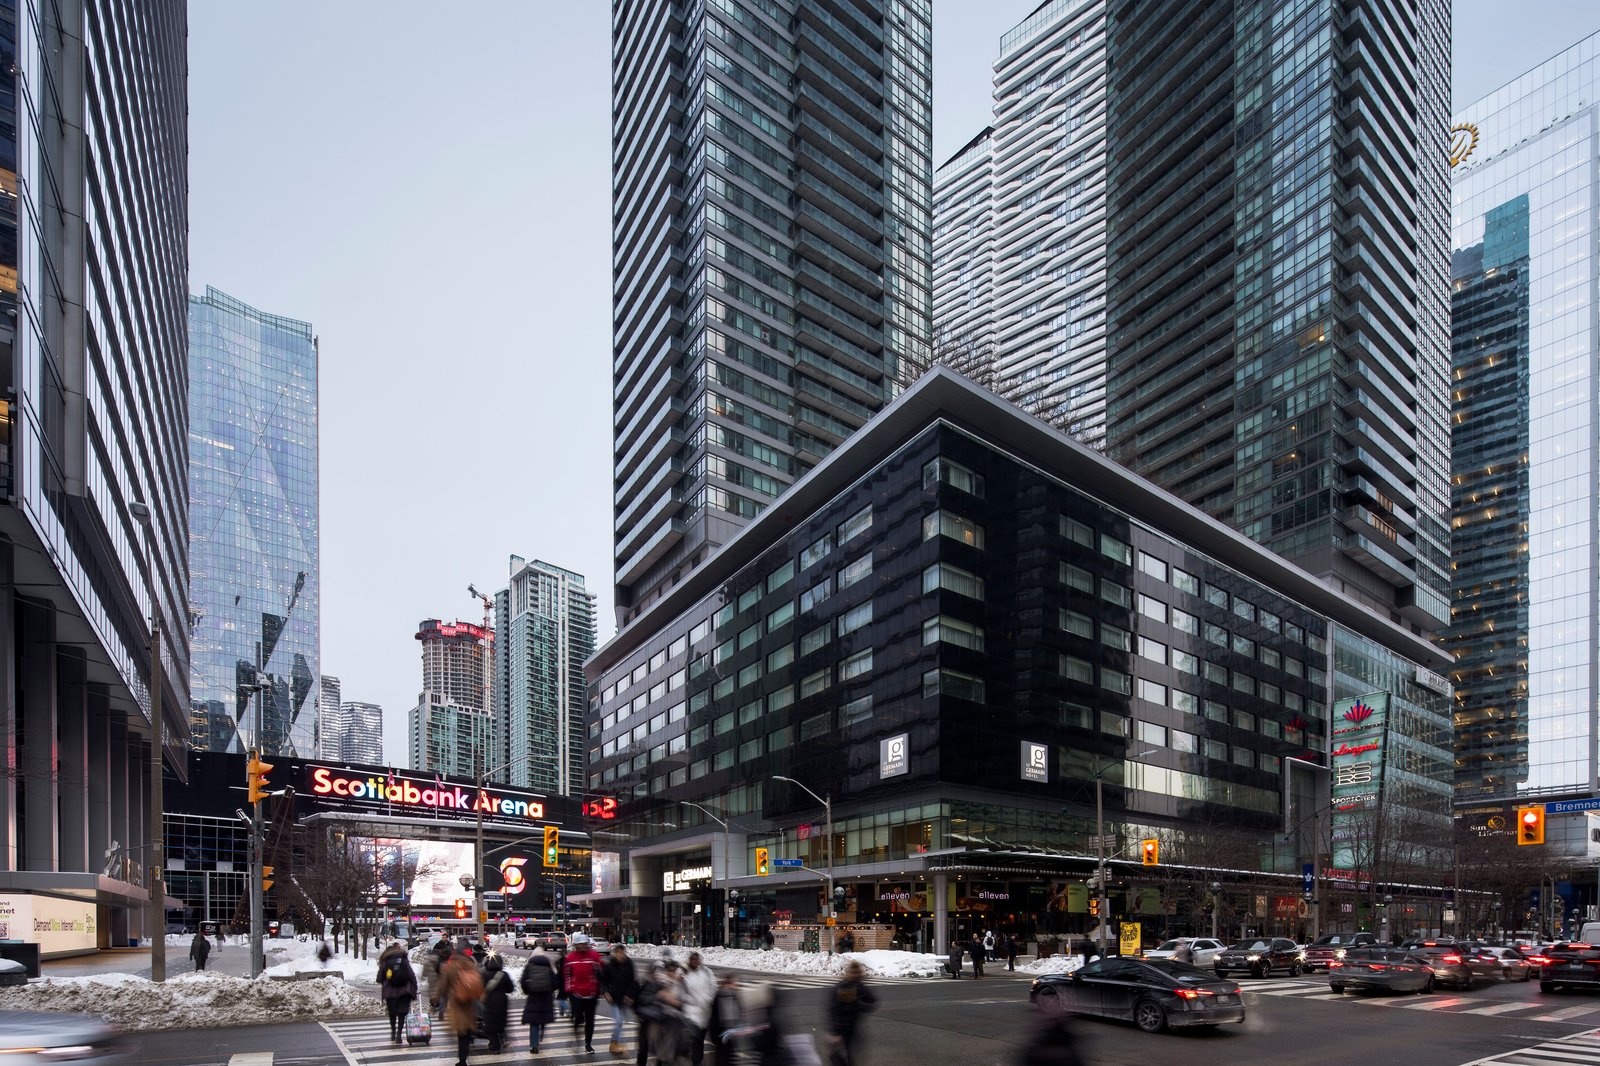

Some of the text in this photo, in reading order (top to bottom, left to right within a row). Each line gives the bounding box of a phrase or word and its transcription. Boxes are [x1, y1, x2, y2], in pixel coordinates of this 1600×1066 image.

[883, 762, 903, 771] GERMAIN
[313, 769, 543, 818] Scotiabank Arena
[681, 866, 712, 881] GERMAIN
[880, 892, 911, 900] elleven
[33, 918, 51, 931] Demand
[61, 919, 74, 931] Internet
